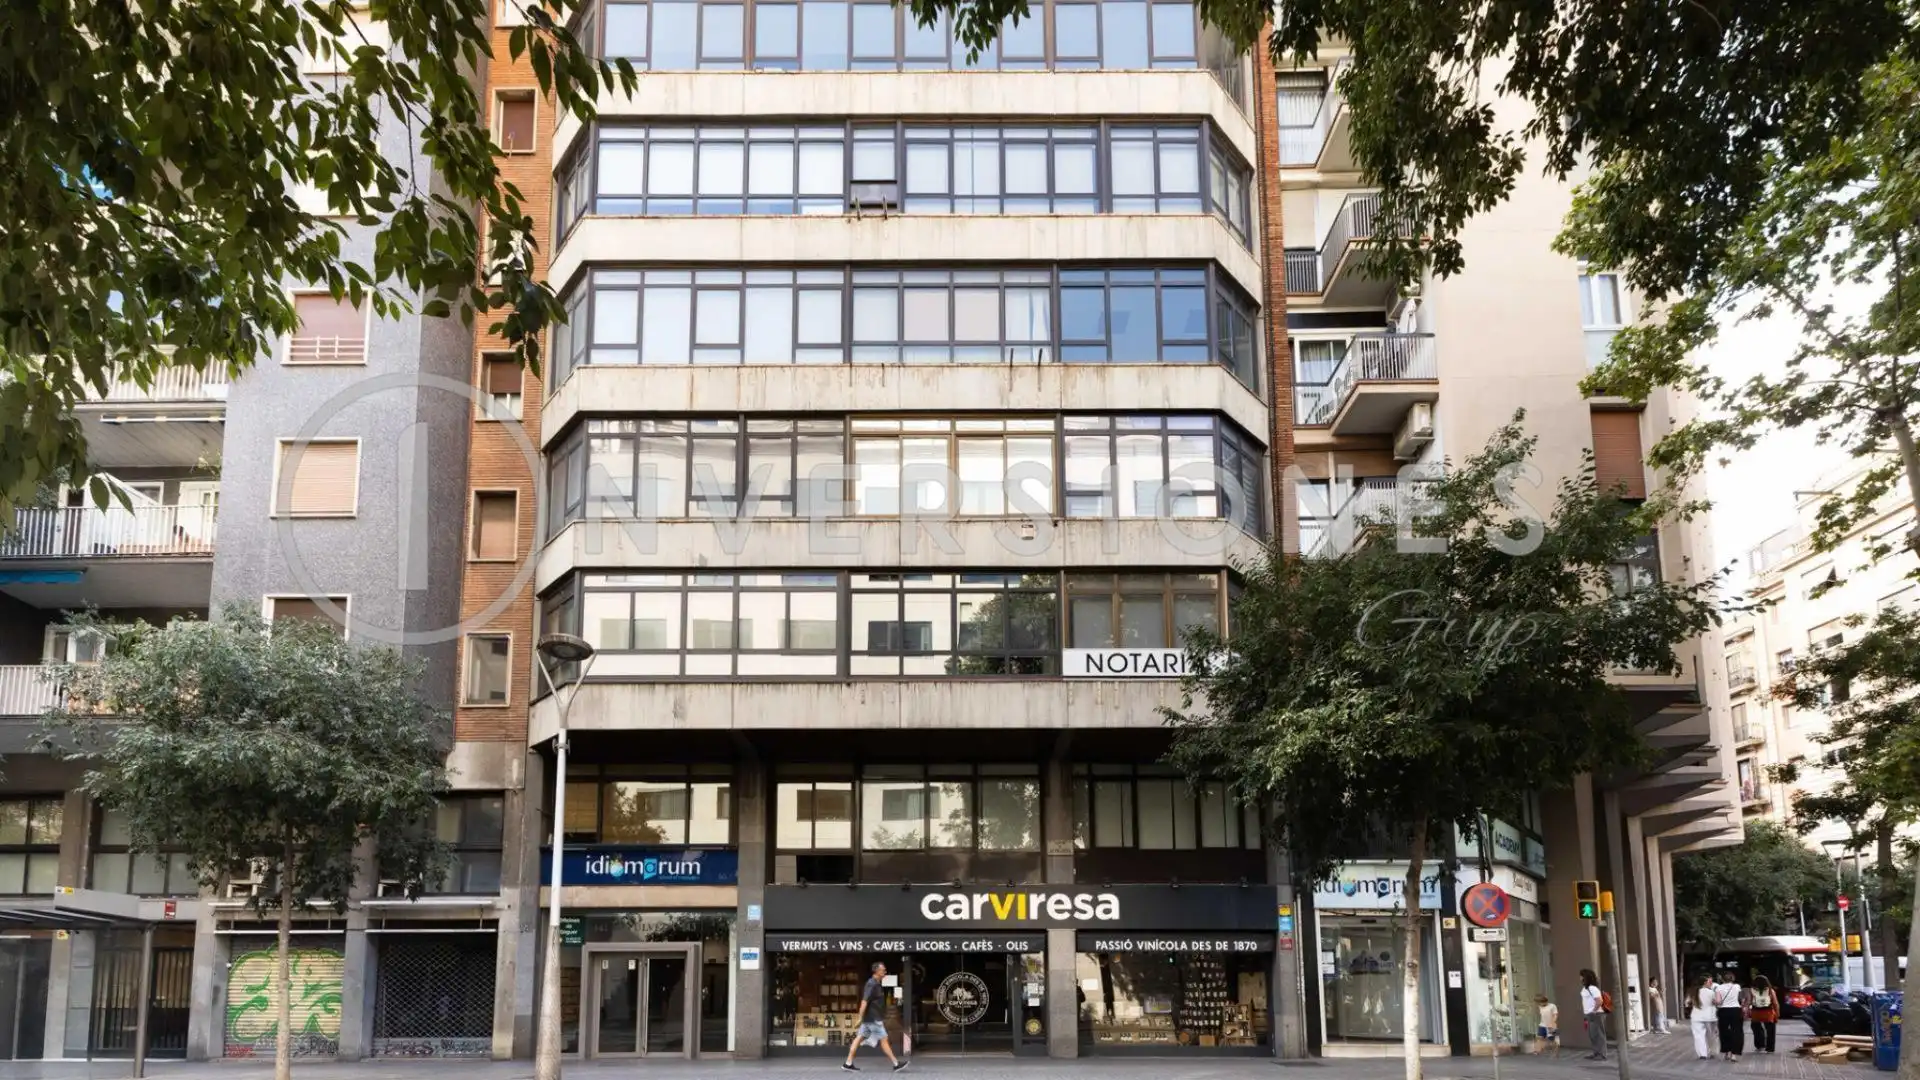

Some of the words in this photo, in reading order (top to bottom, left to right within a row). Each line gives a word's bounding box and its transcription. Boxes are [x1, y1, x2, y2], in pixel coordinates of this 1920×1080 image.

[1086, 653, 1203, 673] NOTARI
[920, 893, 1120, 921] carviresa
[781, 941, 828, 951] VERMUTS
[839, 941, 863, 951] VINS
[873, 941, 905, 951] CAVES
[916, 941, 951, 951] LICORS
[962, 939, 993, 951] CAFÈS
[1006, 941, 1029, 951] OLIS
[1095, 938, 1133, 950] PASSIÓ
[1137, 938, 1188, 951] VINÍCOLA
[1191, 940, 1212, 951] DES
[1216, 940, 1229, 951] DE
[1233, 940, 1258, 951] 1870
